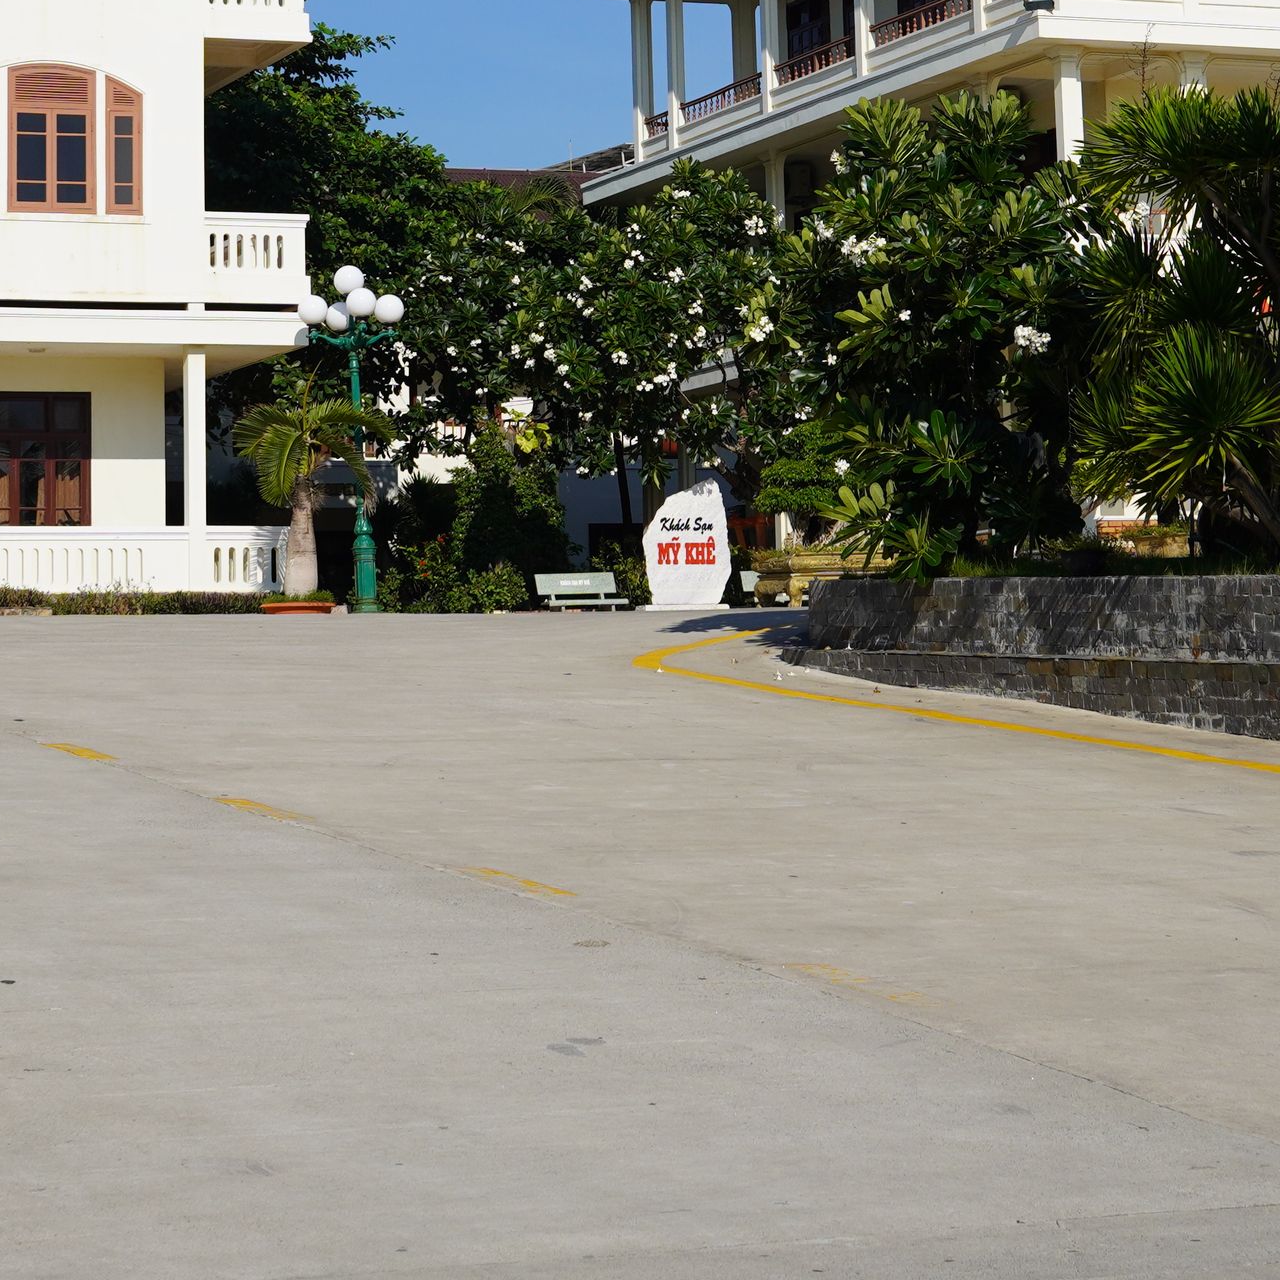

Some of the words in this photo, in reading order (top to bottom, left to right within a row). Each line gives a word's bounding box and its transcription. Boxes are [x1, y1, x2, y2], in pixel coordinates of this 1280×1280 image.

[660, 517, 690, 532] Khách
[693, 516, 714, 535] Sạn
[657, 536, 681, 565] MỸ
[685, 535, 716, 565] KHÊ
